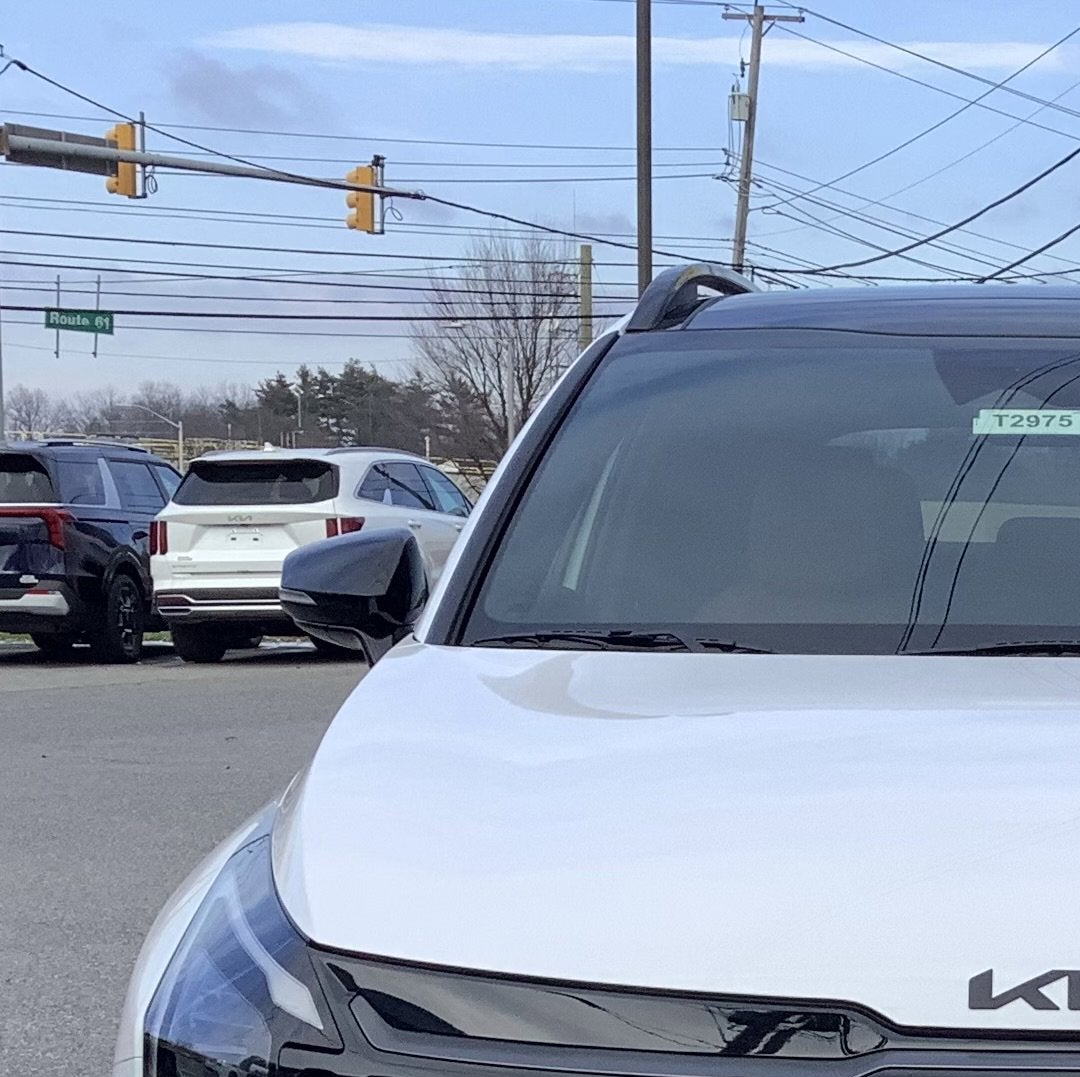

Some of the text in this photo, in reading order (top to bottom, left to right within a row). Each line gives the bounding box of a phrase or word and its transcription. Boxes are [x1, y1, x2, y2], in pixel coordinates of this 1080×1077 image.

[49, 311, 110, 330] Route 61
[992, 414, 1073, 428] T2975
